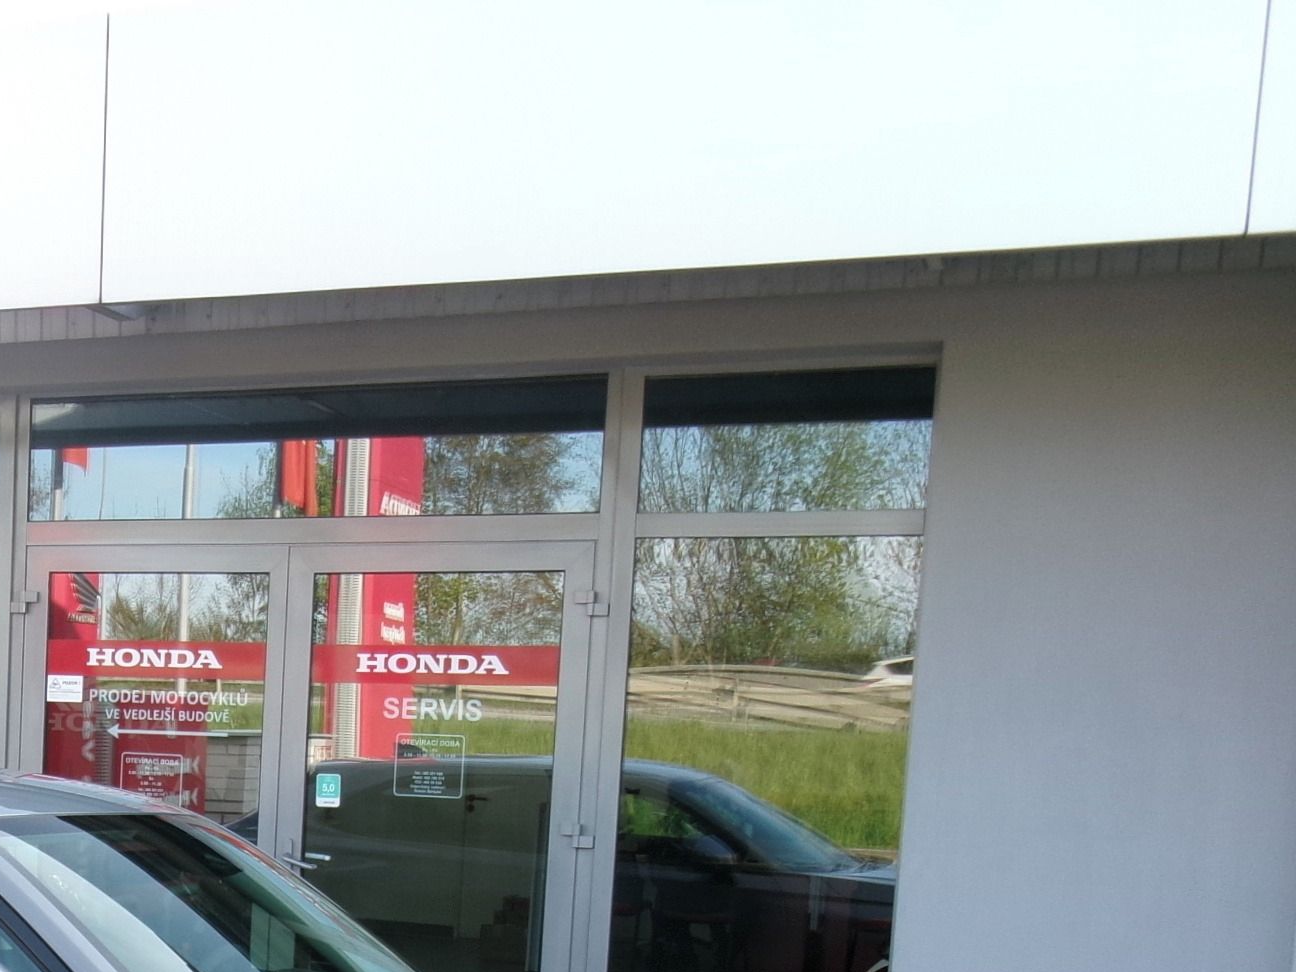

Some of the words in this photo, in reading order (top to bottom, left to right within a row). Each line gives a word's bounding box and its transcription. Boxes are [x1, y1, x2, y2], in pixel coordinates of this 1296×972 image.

[86, 647, 223, 669] HONDA
[355, 653, 510, 675] HONDA
[89, 689, 145, 705] PRODEJ
[150, 688, 248, 706] MOTOCYKLŮ
[106, 708, 119, 720] VE
[123, 706, 175, 722] VEDLEJŠÍ
[179, 708, 230, 723] BUDOVĚ
[382, 697, 482, 721] SERVIS
